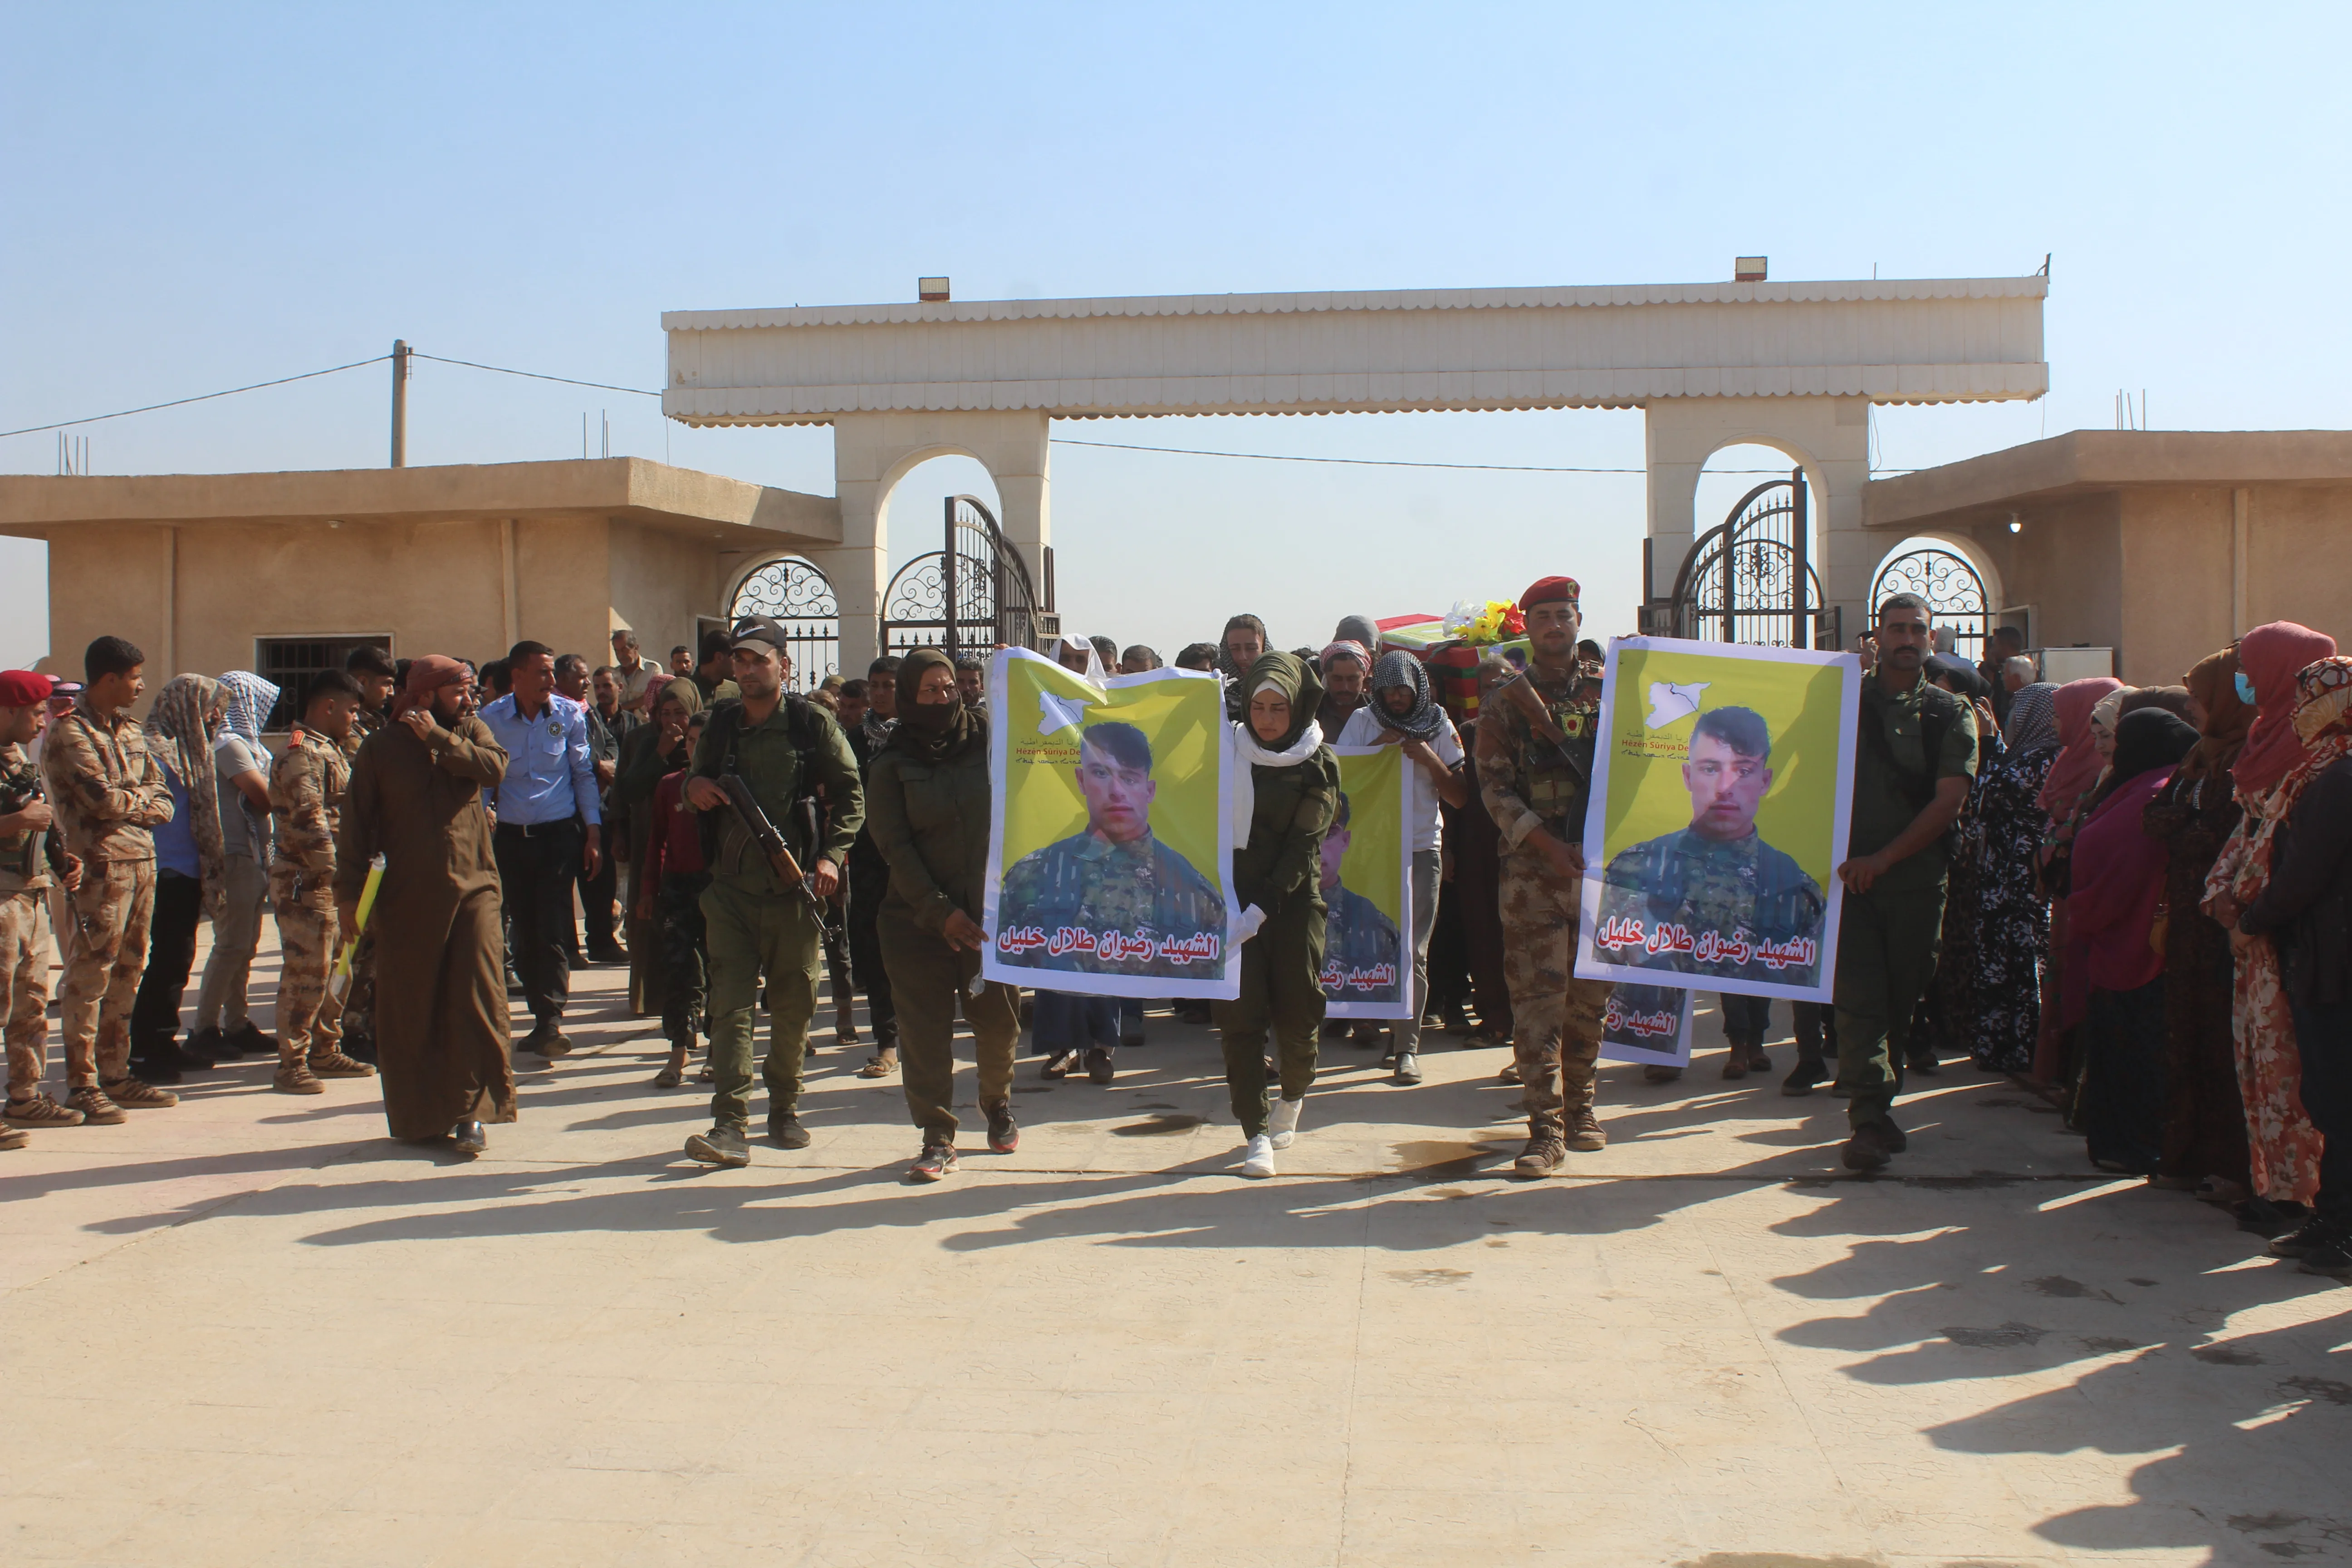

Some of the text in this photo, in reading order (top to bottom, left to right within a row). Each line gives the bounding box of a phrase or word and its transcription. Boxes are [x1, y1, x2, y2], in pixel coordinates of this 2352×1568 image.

[1000, 926, 1219, 963] الشهيد رضوان طلال خليل
[1597, 916, 1814, 968] الشهيد رضوان طلال خليل
[1349, 964, 1394, 990] الشهيد
[1628, 1011, 1675, 1036] الشهيد
